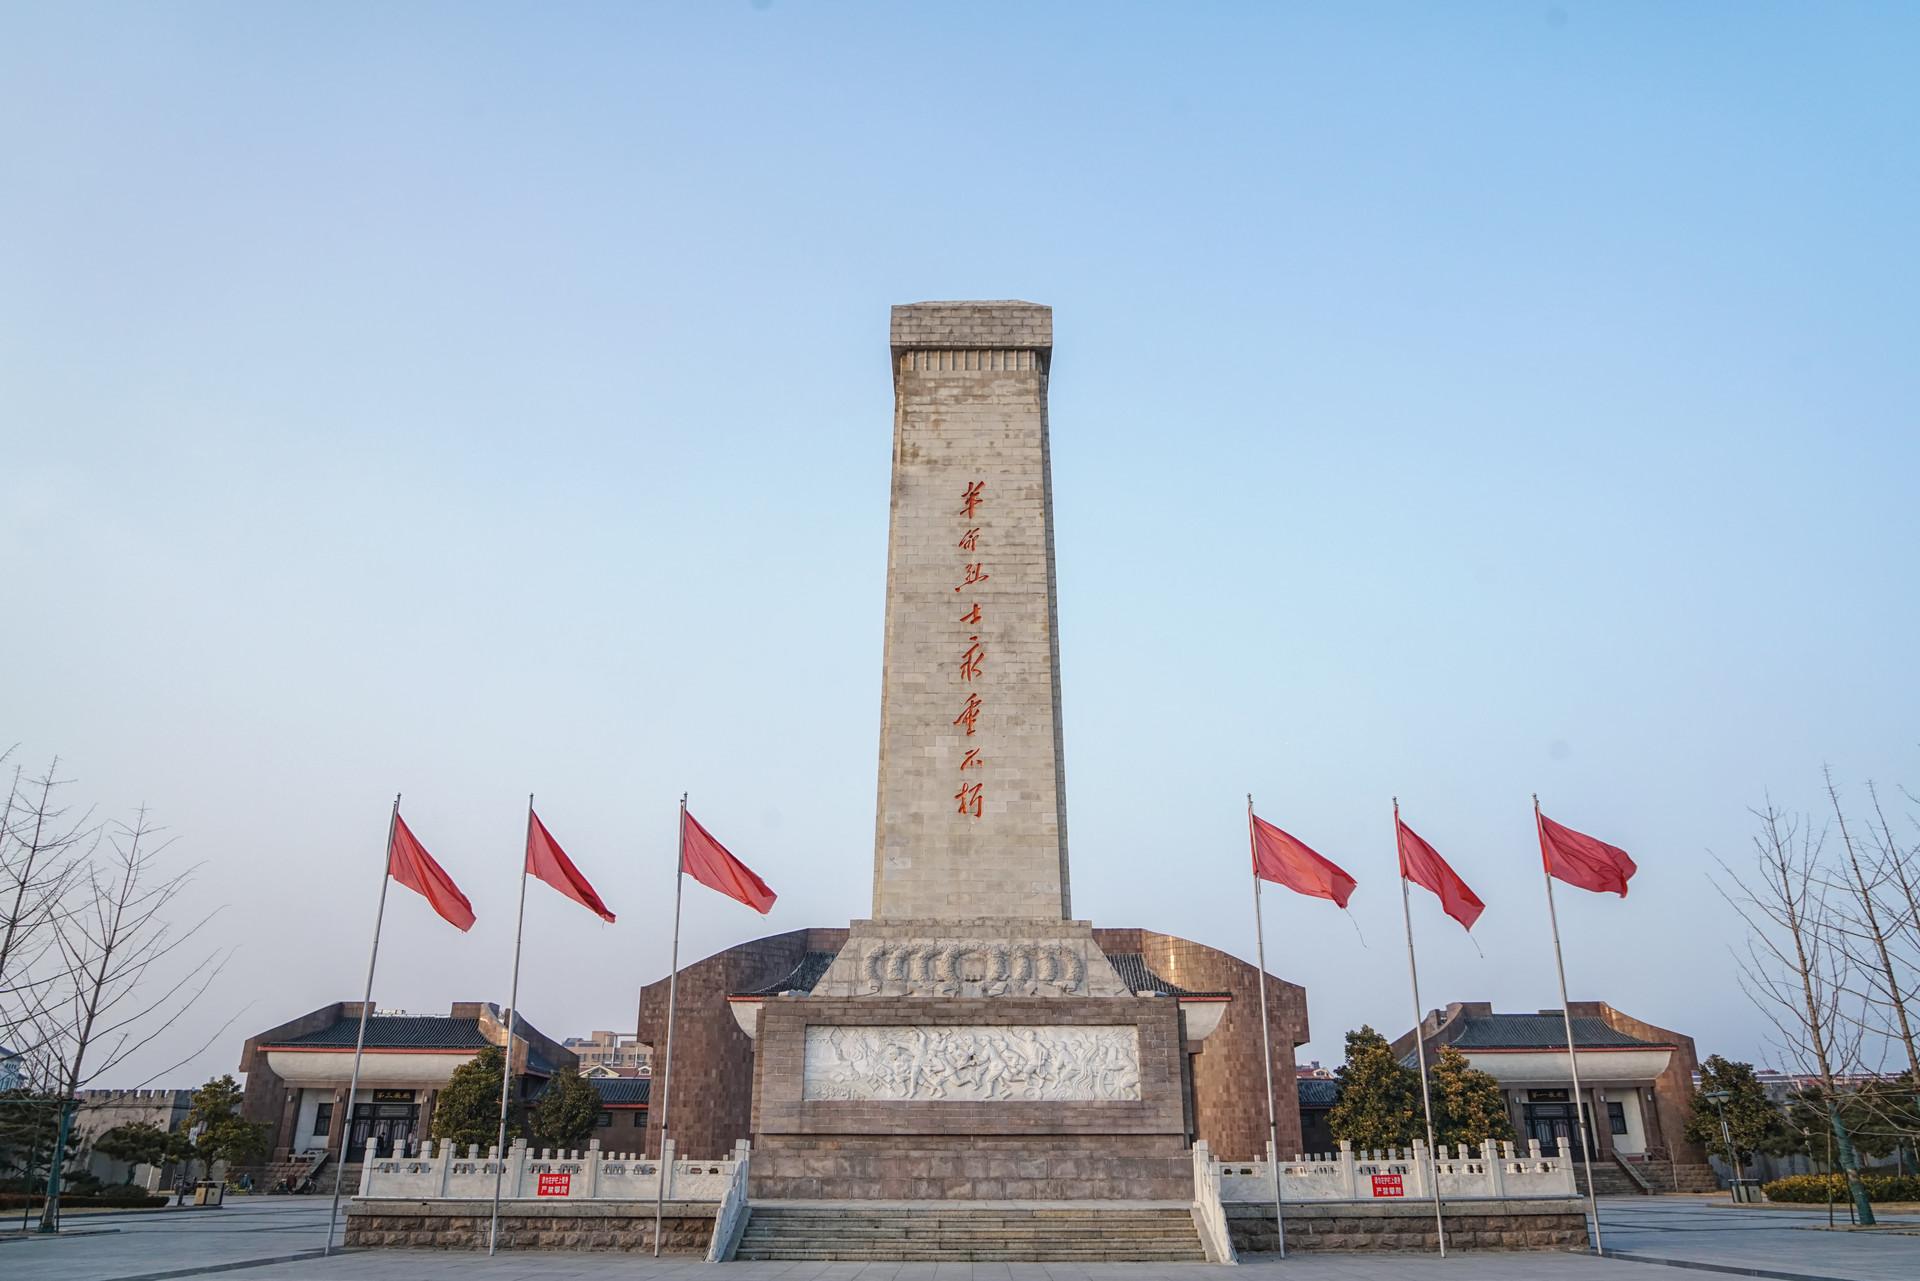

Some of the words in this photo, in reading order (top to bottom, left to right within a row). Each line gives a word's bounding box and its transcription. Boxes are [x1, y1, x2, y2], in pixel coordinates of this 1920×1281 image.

[953, 481, 989, 818] 革命烈士永垂不朽
[540, 1186, 568, 1195] 严禁攀爬
